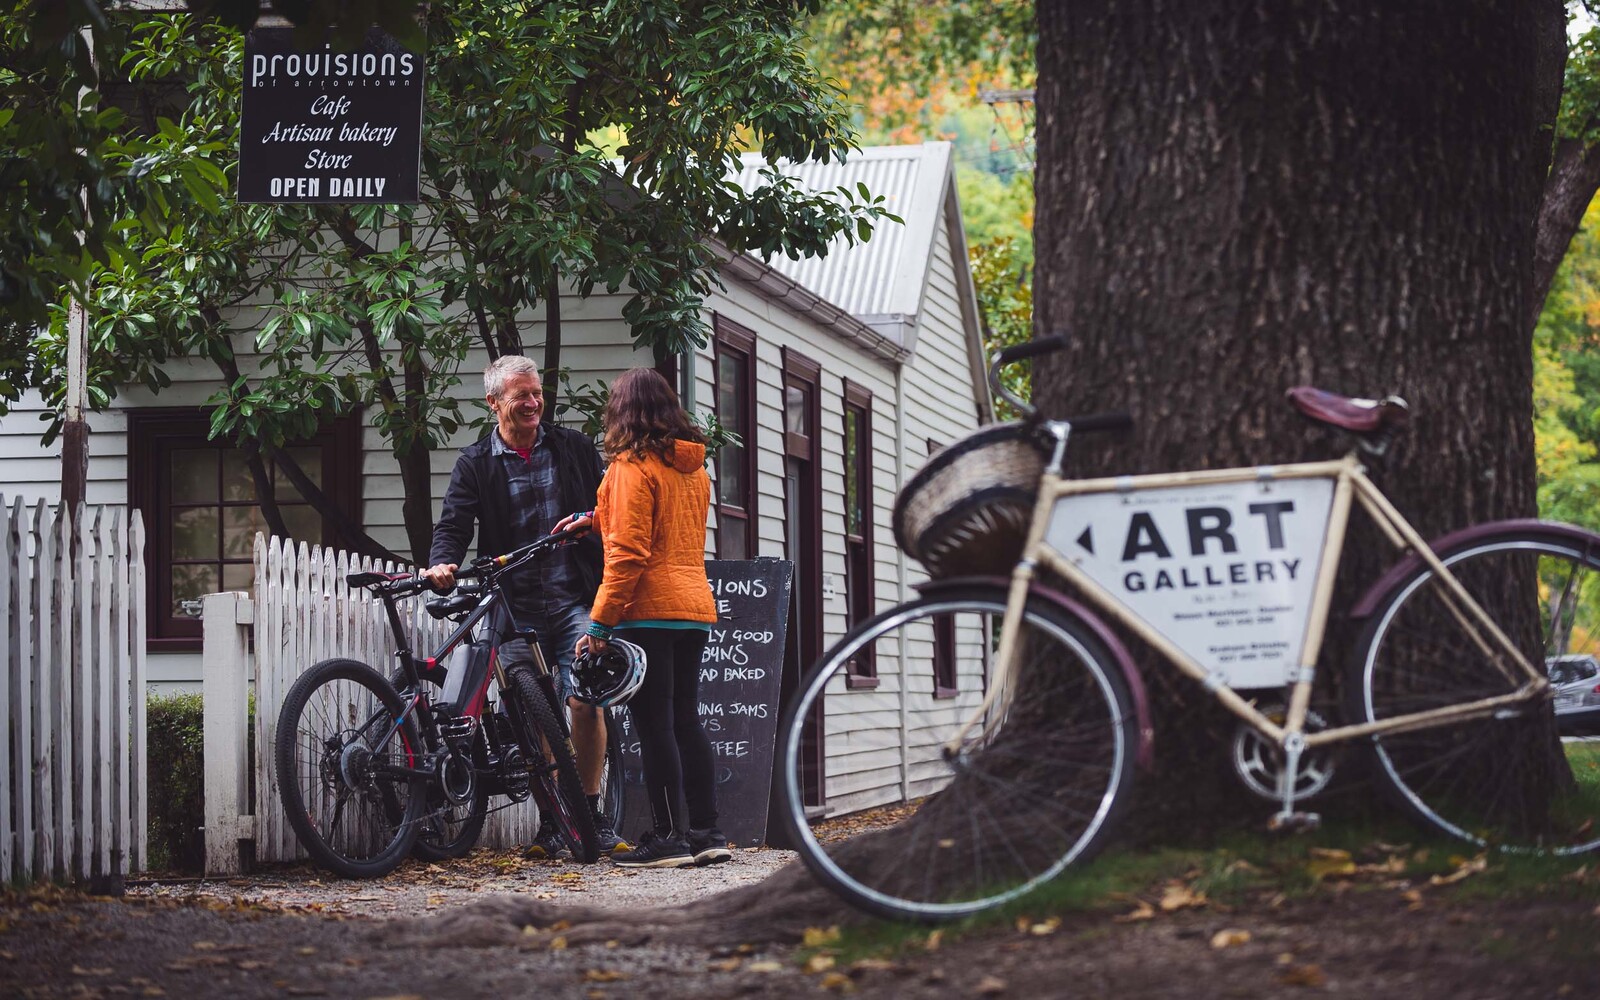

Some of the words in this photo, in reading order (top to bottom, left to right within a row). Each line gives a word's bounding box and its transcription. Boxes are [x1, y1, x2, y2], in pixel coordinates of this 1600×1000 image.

[252, 43, 414, 87] provisions
[259, 79, 276, 87] of
[294, 79, 410, 88] arrowtown
[310, 95, 352, 120] Cafe
[262, 121, 334, 144] Artisan
[339, 122, 398, 147] bakery
[304, 149, 352, 169] Store
[270, 178, 320, 198] OPEN
[329, 178, 386, 197] DAILY
[1121, 501, 1294, 562] ART
[1124, 559, 1301, 592] GALLERY
[732, 629, 774, 644] GOOD
[723, 667, 766, 682] BAKED
[729, 701, 768, 718] JAMS
